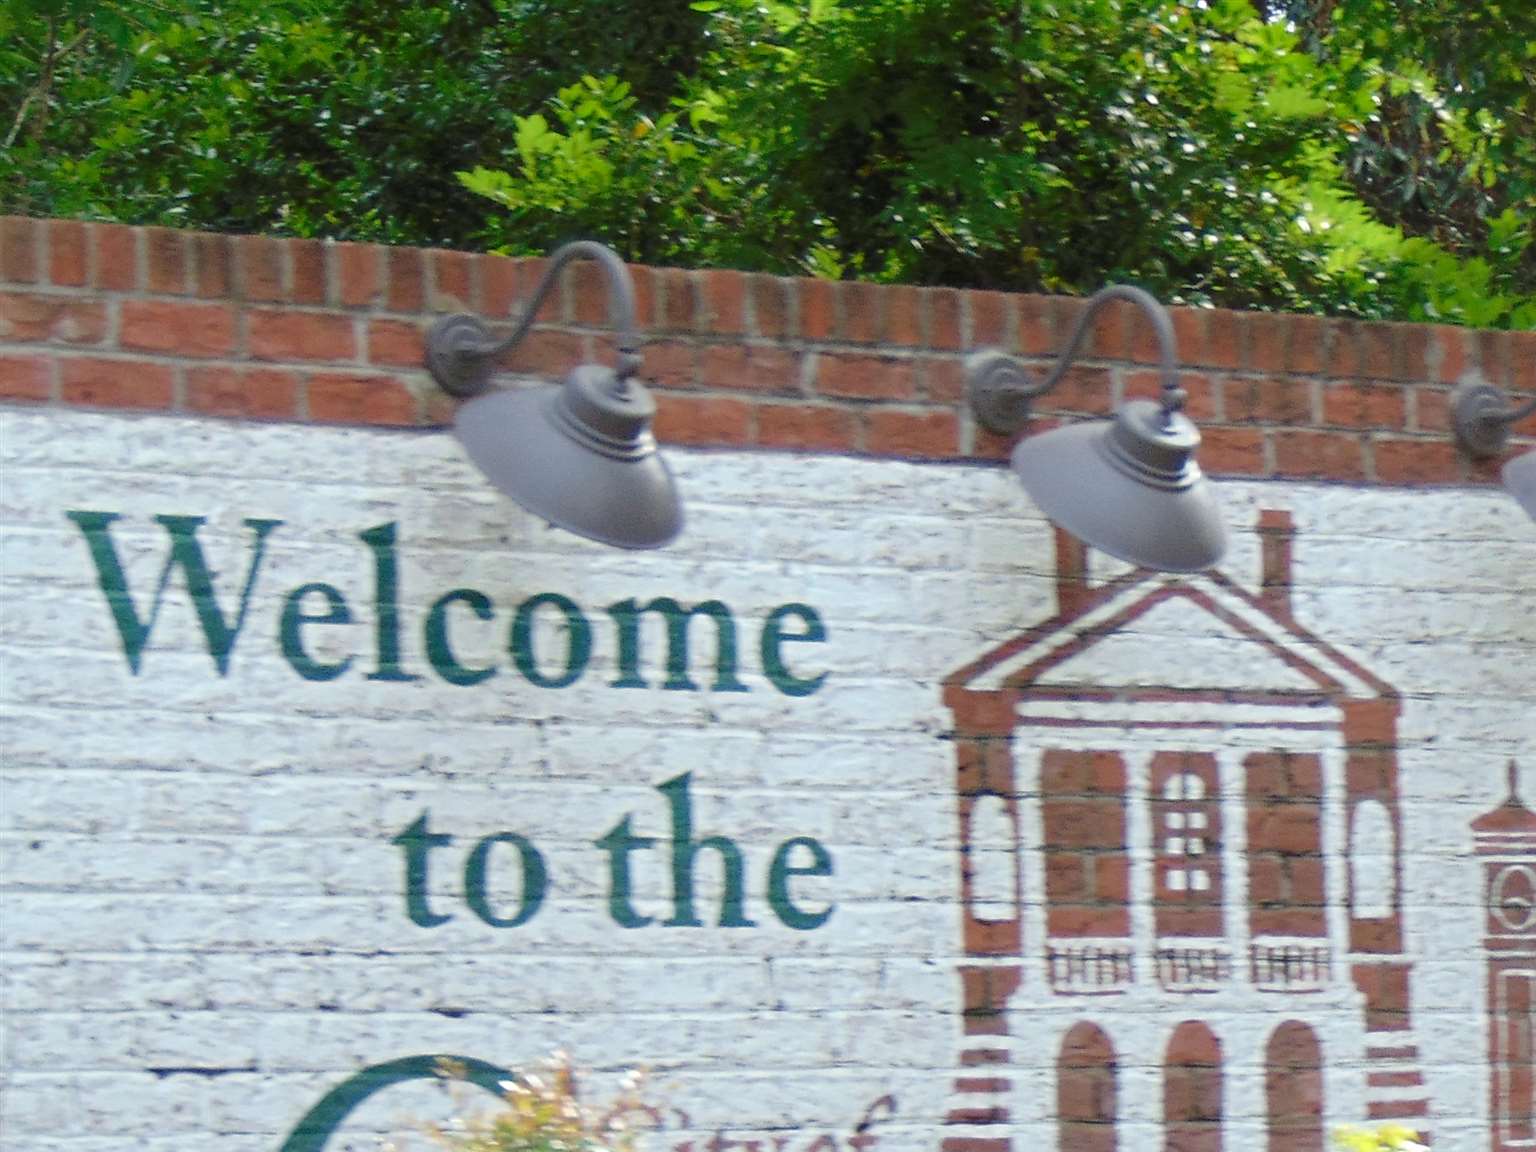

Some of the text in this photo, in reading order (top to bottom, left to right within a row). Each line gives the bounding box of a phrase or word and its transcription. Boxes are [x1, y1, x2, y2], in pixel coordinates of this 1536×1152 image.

[66, 509, 831, 697] Welcome
[391, 770, 835, 931] to the
